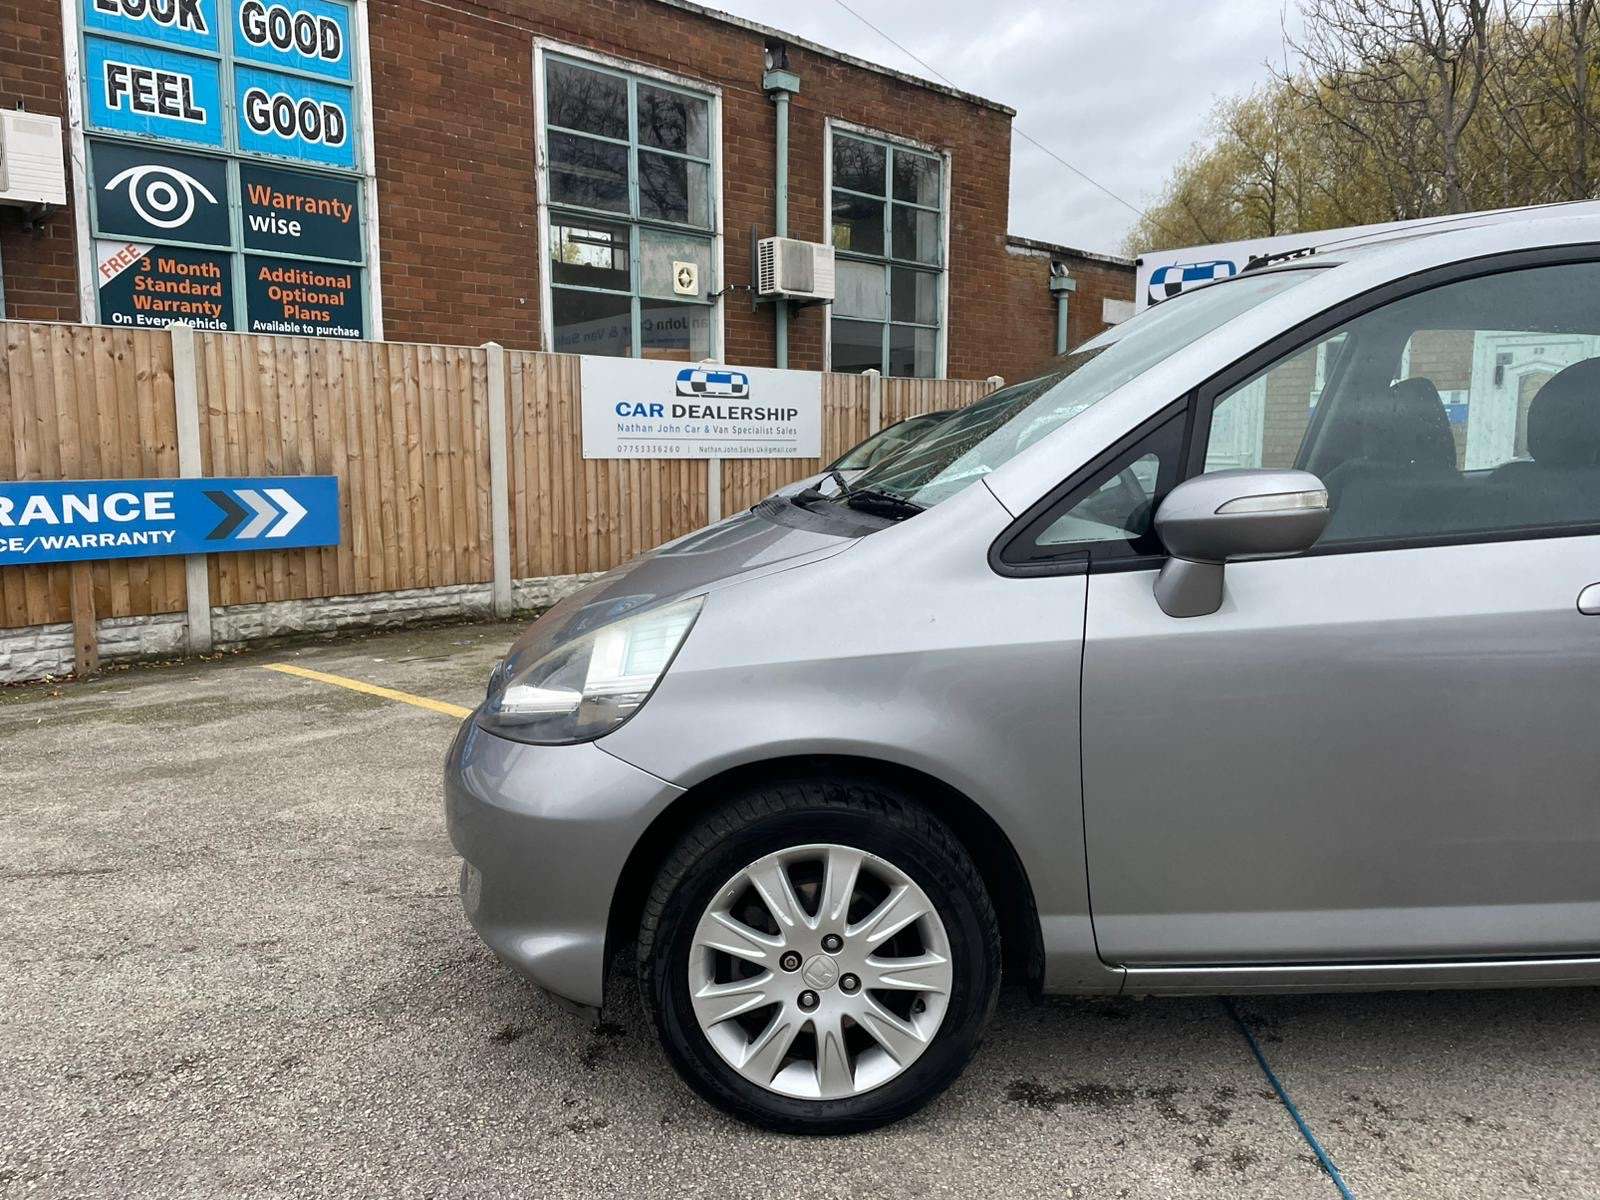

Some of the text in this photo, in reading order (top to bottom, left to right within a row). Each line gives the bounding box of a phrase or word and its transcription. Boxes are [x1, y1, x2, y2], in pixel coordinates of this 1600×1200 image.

[96, 0, 341, 61] OK GOOD
[105, 62, 345, 145] FEEL GOOD
[248, 183, 352, 223] Warranty
[249, 212, 301, 237] wise
[99, 243, 141, 279] FREE
[141, 256, 220, 278] 3 Month
[134, 275, 221, 297] Standard
[258, 266, 351, 289] Additional
[133, 295, 221, 318] Warranty
[268, 286, 344, 306] Optional
[112, 312, 132, 324] On
[284, 305, 330, 322] Plans
[253, 320, 360, 338] Available to purchase
[615, 401, 798, 421] CAR DEALERSHIP
[617, 423, 797, 436] Nathan John Car & Van Specialist Sales
